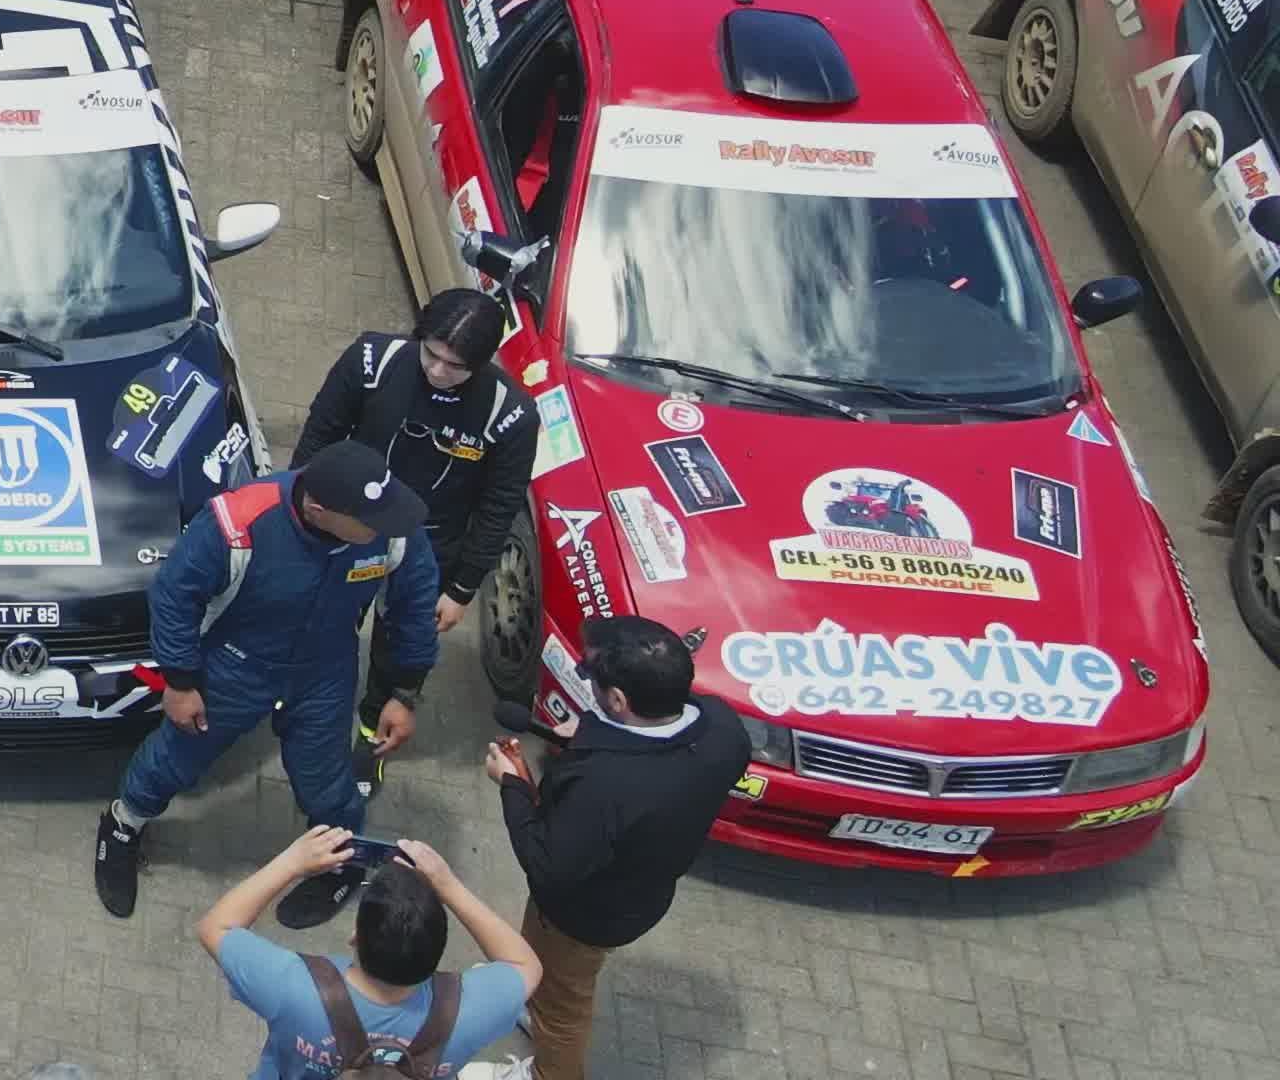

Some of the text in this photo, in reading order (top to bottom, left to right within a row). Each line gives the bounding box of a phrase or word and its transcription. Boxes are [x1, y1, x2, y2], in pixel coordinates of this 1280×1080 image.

[92, 97, 143, 110] AVOSUR
[624, 133, 683, 146] AVOSUR
[719, 140, 877, 168] Rally Avosur
[947, 148, 1000, 167] AVOSUR
[122, 383, 157, 413] 49
[3, 538, 86, 553] SYSTEMS
[831, 570, 994, 592] PURRANQUE
[880, 556, 896, 573] 9
[903, 557, 1025, 584] 88045240
[14, 607, 33, 623] VF
[727, 624, 1116, 691] GRÚAS vive
[798, 685, 887, 709] 642
[928, 687, 1101, 720] 249827
